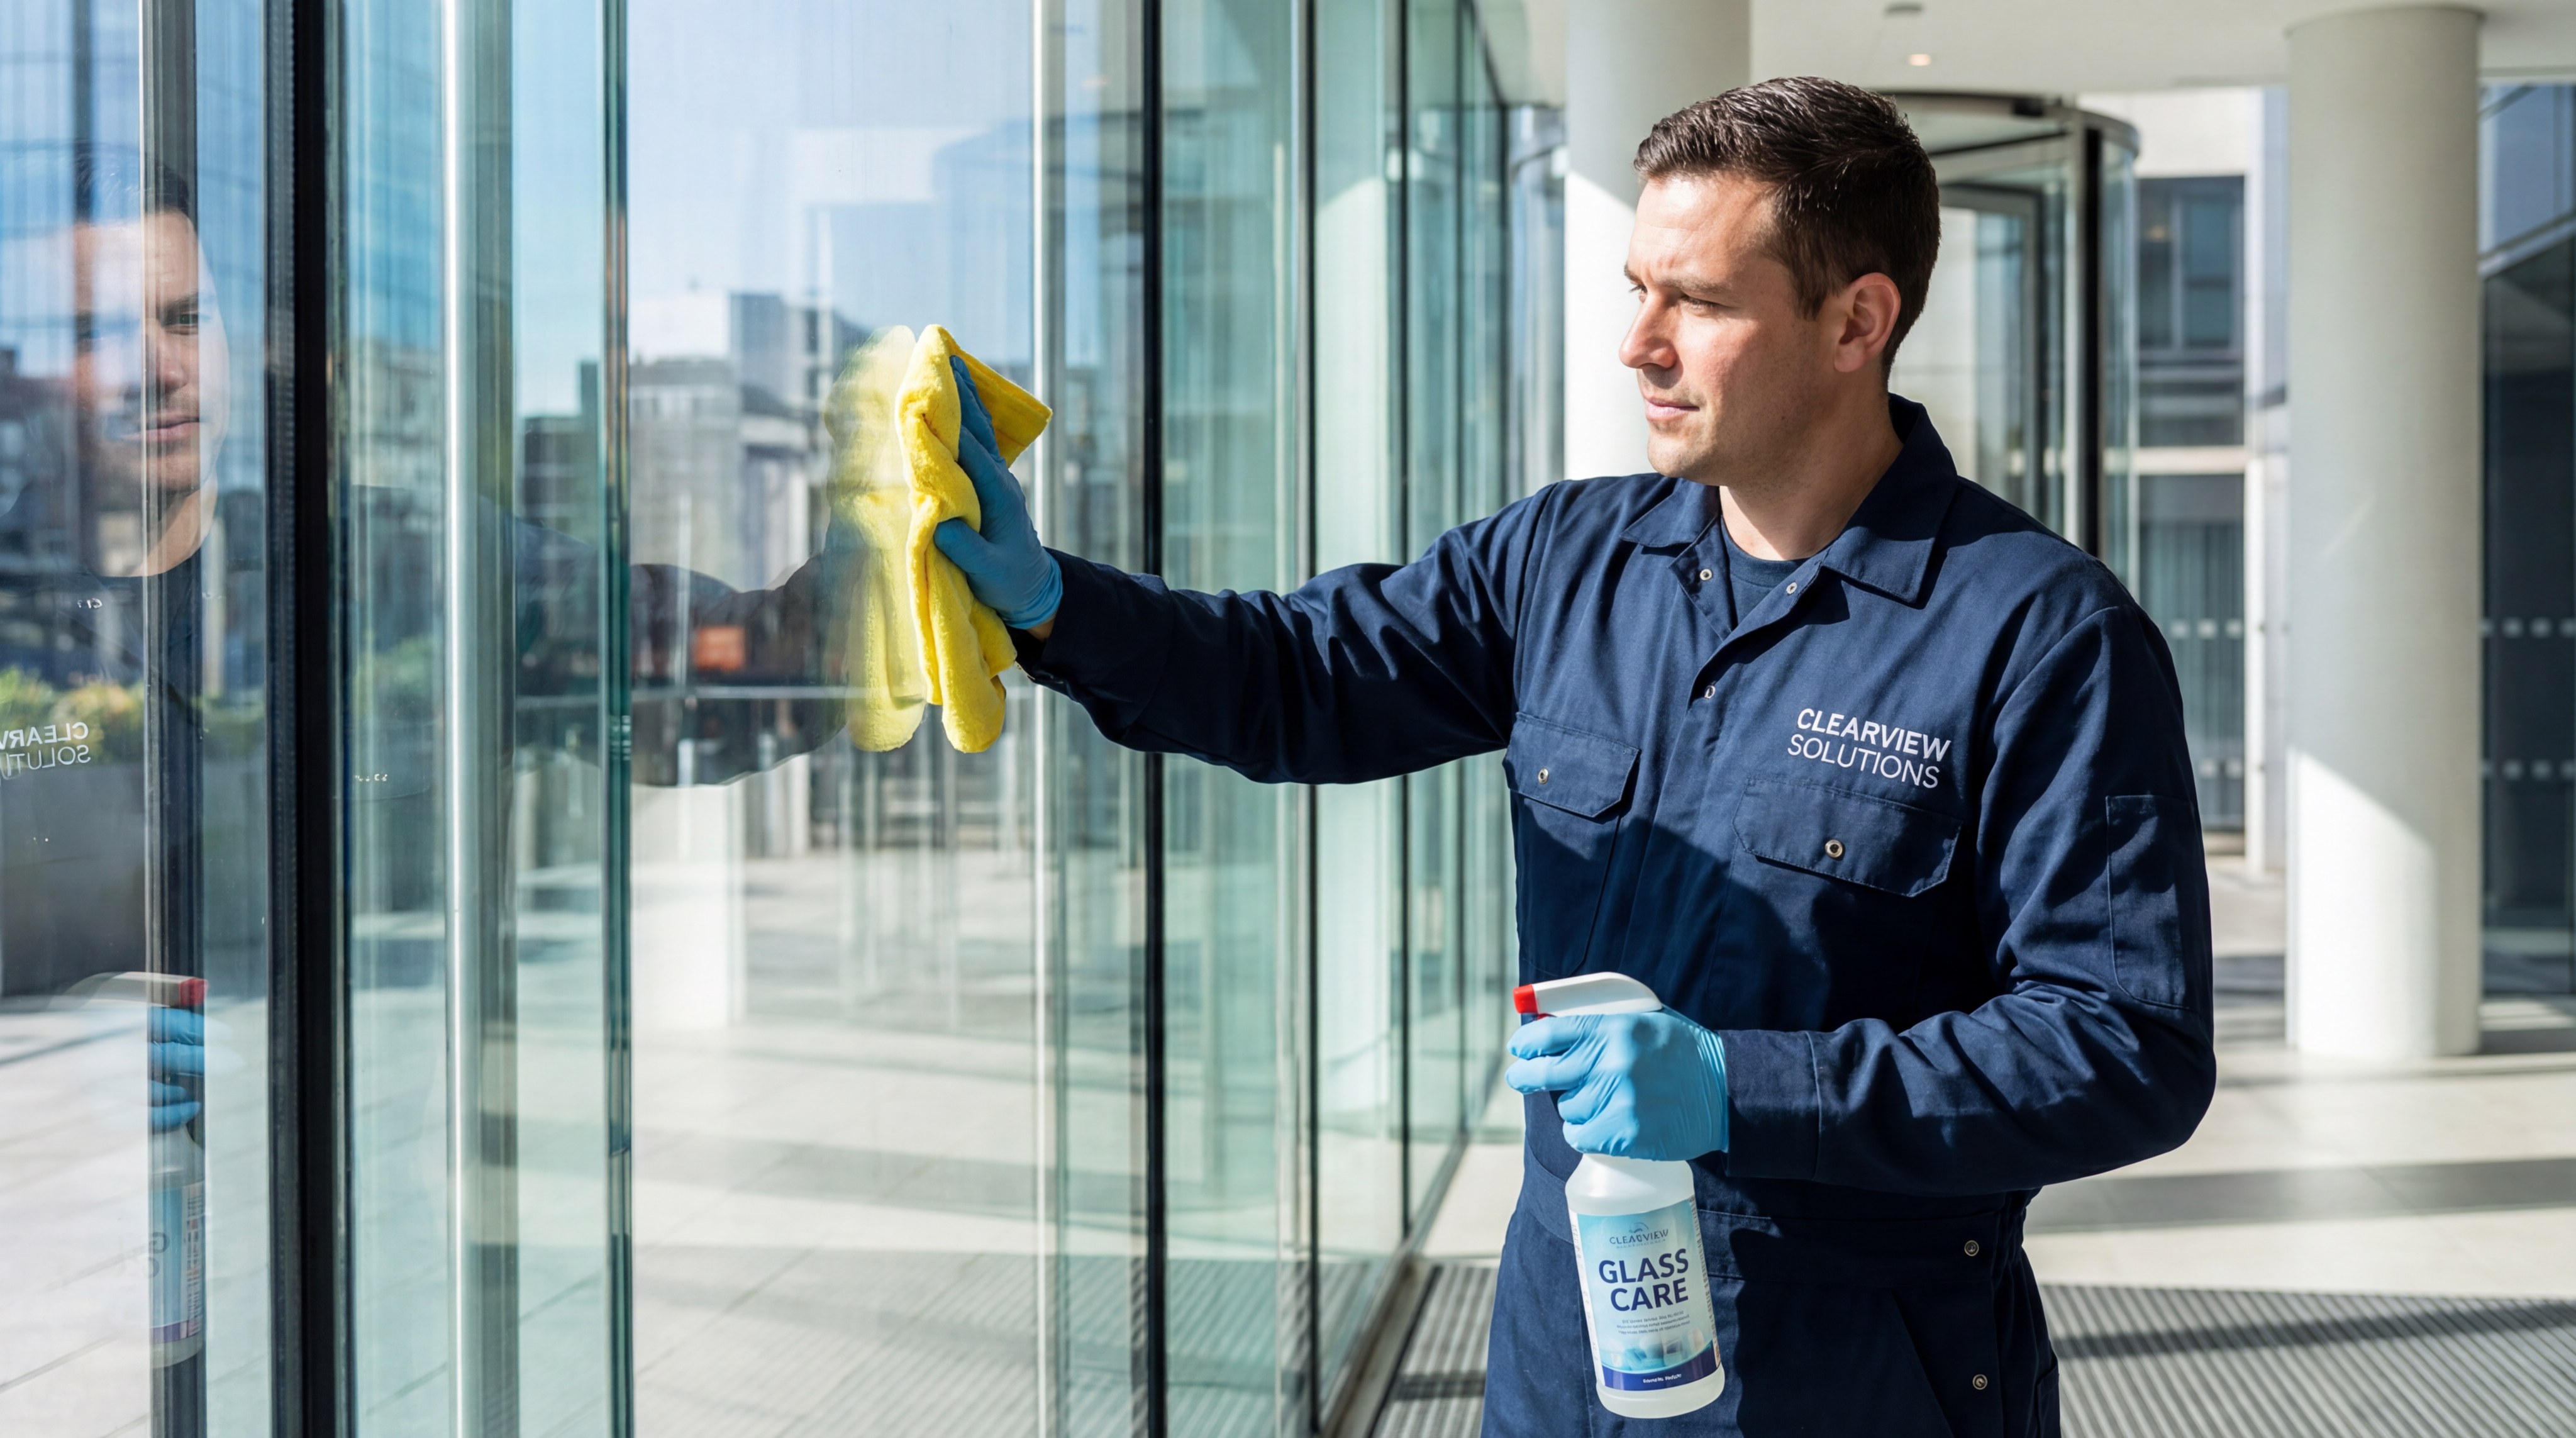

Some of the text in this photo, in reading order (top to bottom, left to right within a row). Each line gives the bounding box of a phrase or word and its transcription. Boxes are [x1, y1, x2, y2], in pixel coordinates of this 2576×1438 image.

[1797, 708, 1951, 762] CLEARVIEW
[1787, 734, 1940, 788] SOLUTIONS
[1598, 1248, 1689, 1284] GLASS
[1610, 1278, 1689, 1312] CARE
